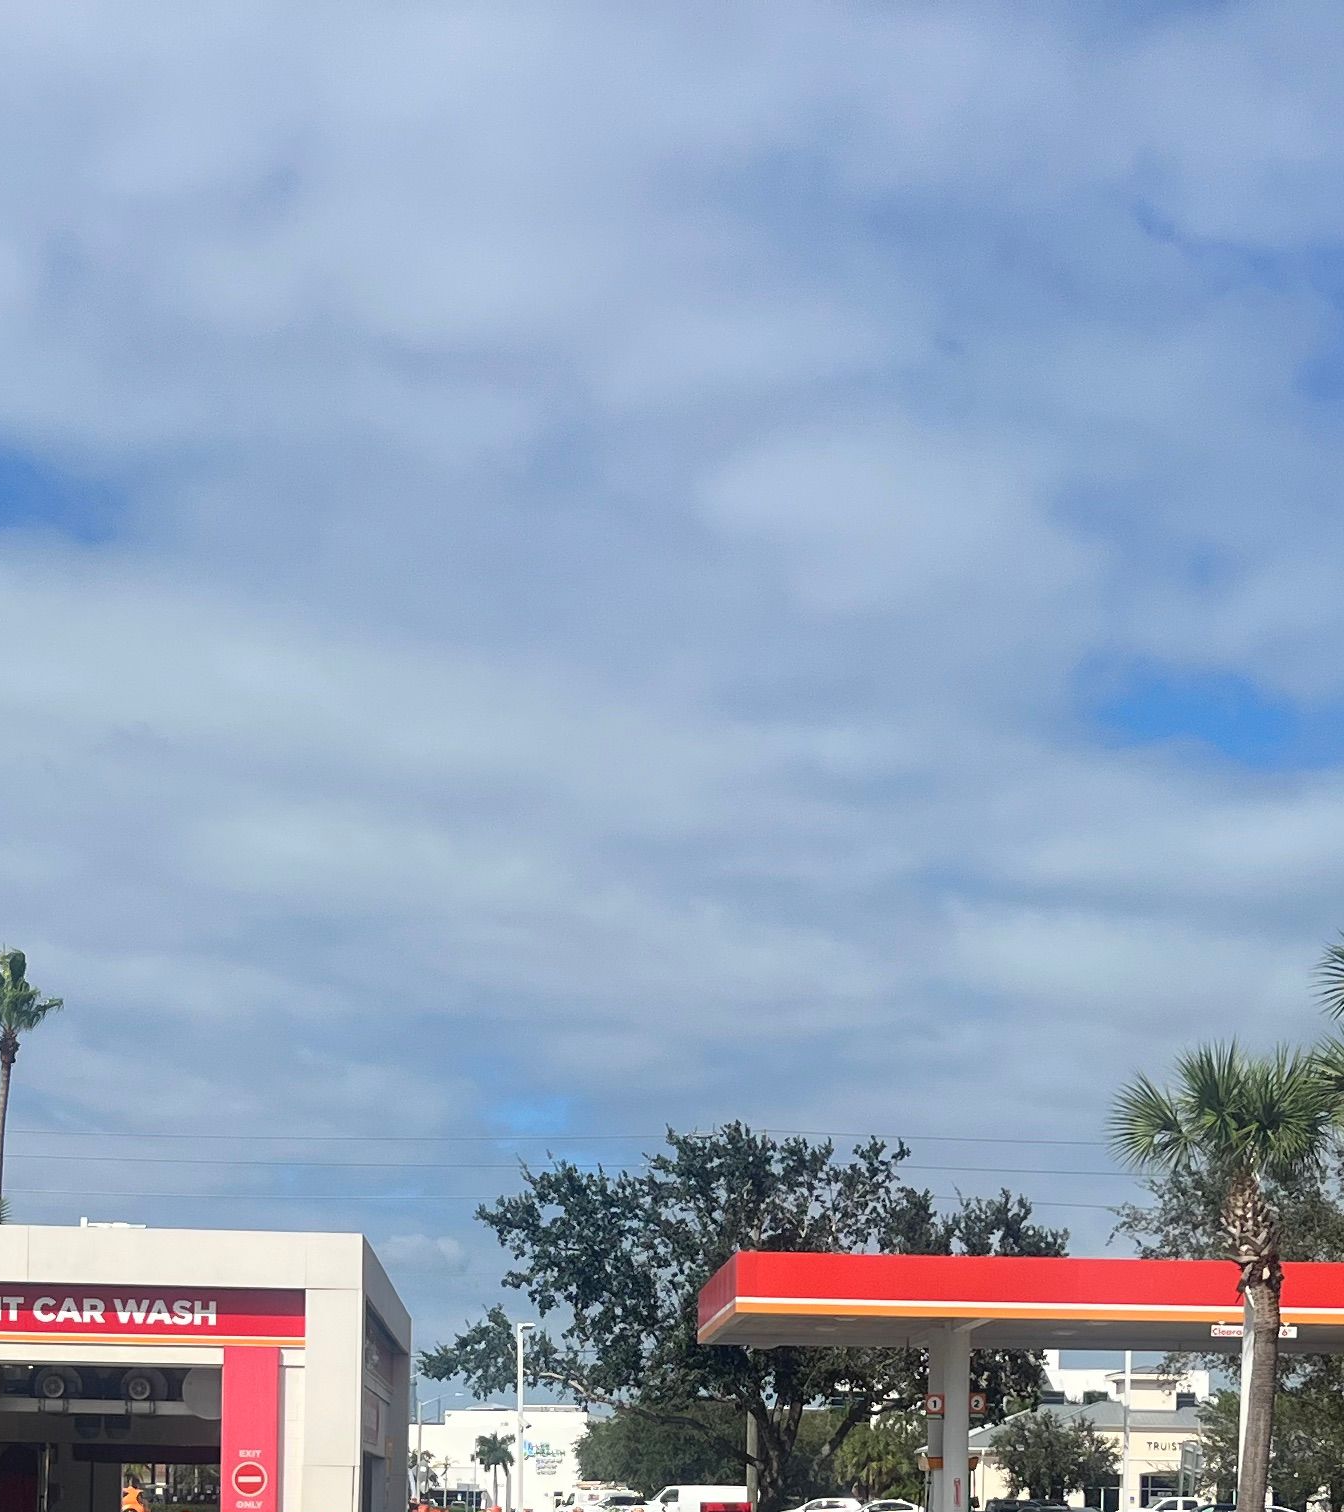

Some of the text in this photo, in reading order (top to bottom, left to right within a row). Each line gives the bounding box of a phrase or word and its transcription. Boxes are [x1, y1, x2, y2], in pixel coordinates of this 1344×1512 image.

[32, 1297, 106, 1324] CAR
[113, 1298, 217, 1326] WASH
[238, 1449, 262, 1458] EXIT
[236, 1500, 263, 1509] ONLY
